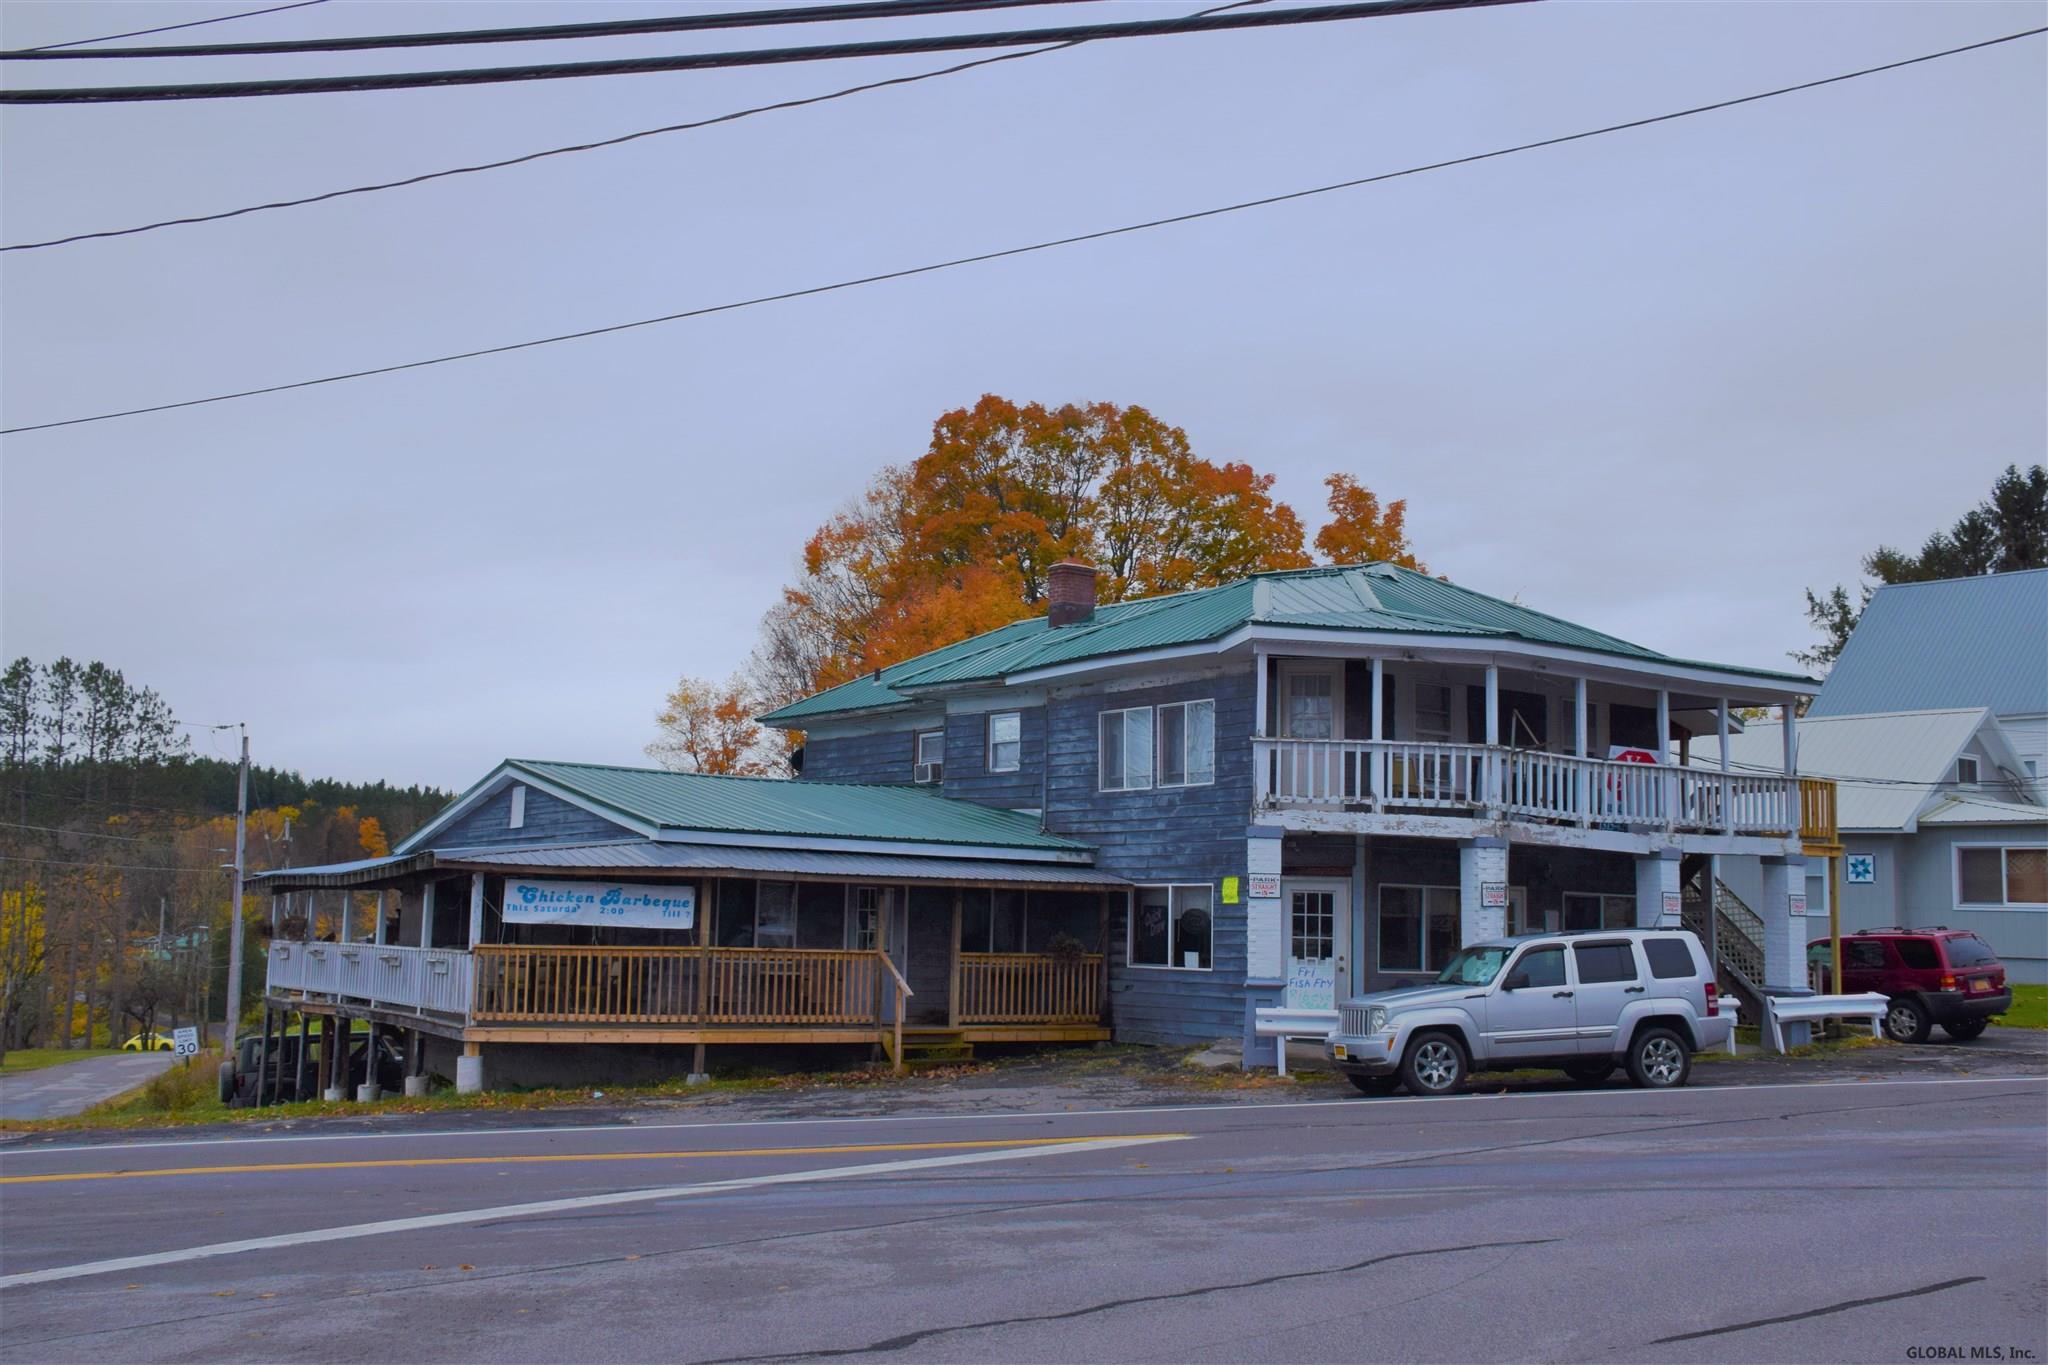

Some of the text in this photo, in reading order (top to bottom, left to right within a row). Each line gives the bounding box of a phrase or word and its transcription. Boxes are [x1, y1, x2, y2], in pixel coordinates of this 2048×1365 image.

[517, 885, 690, 911] Chicken Barbeque
[600, 907, 624, 915] 2:00
[178, 1042, 196, 1055] 30
